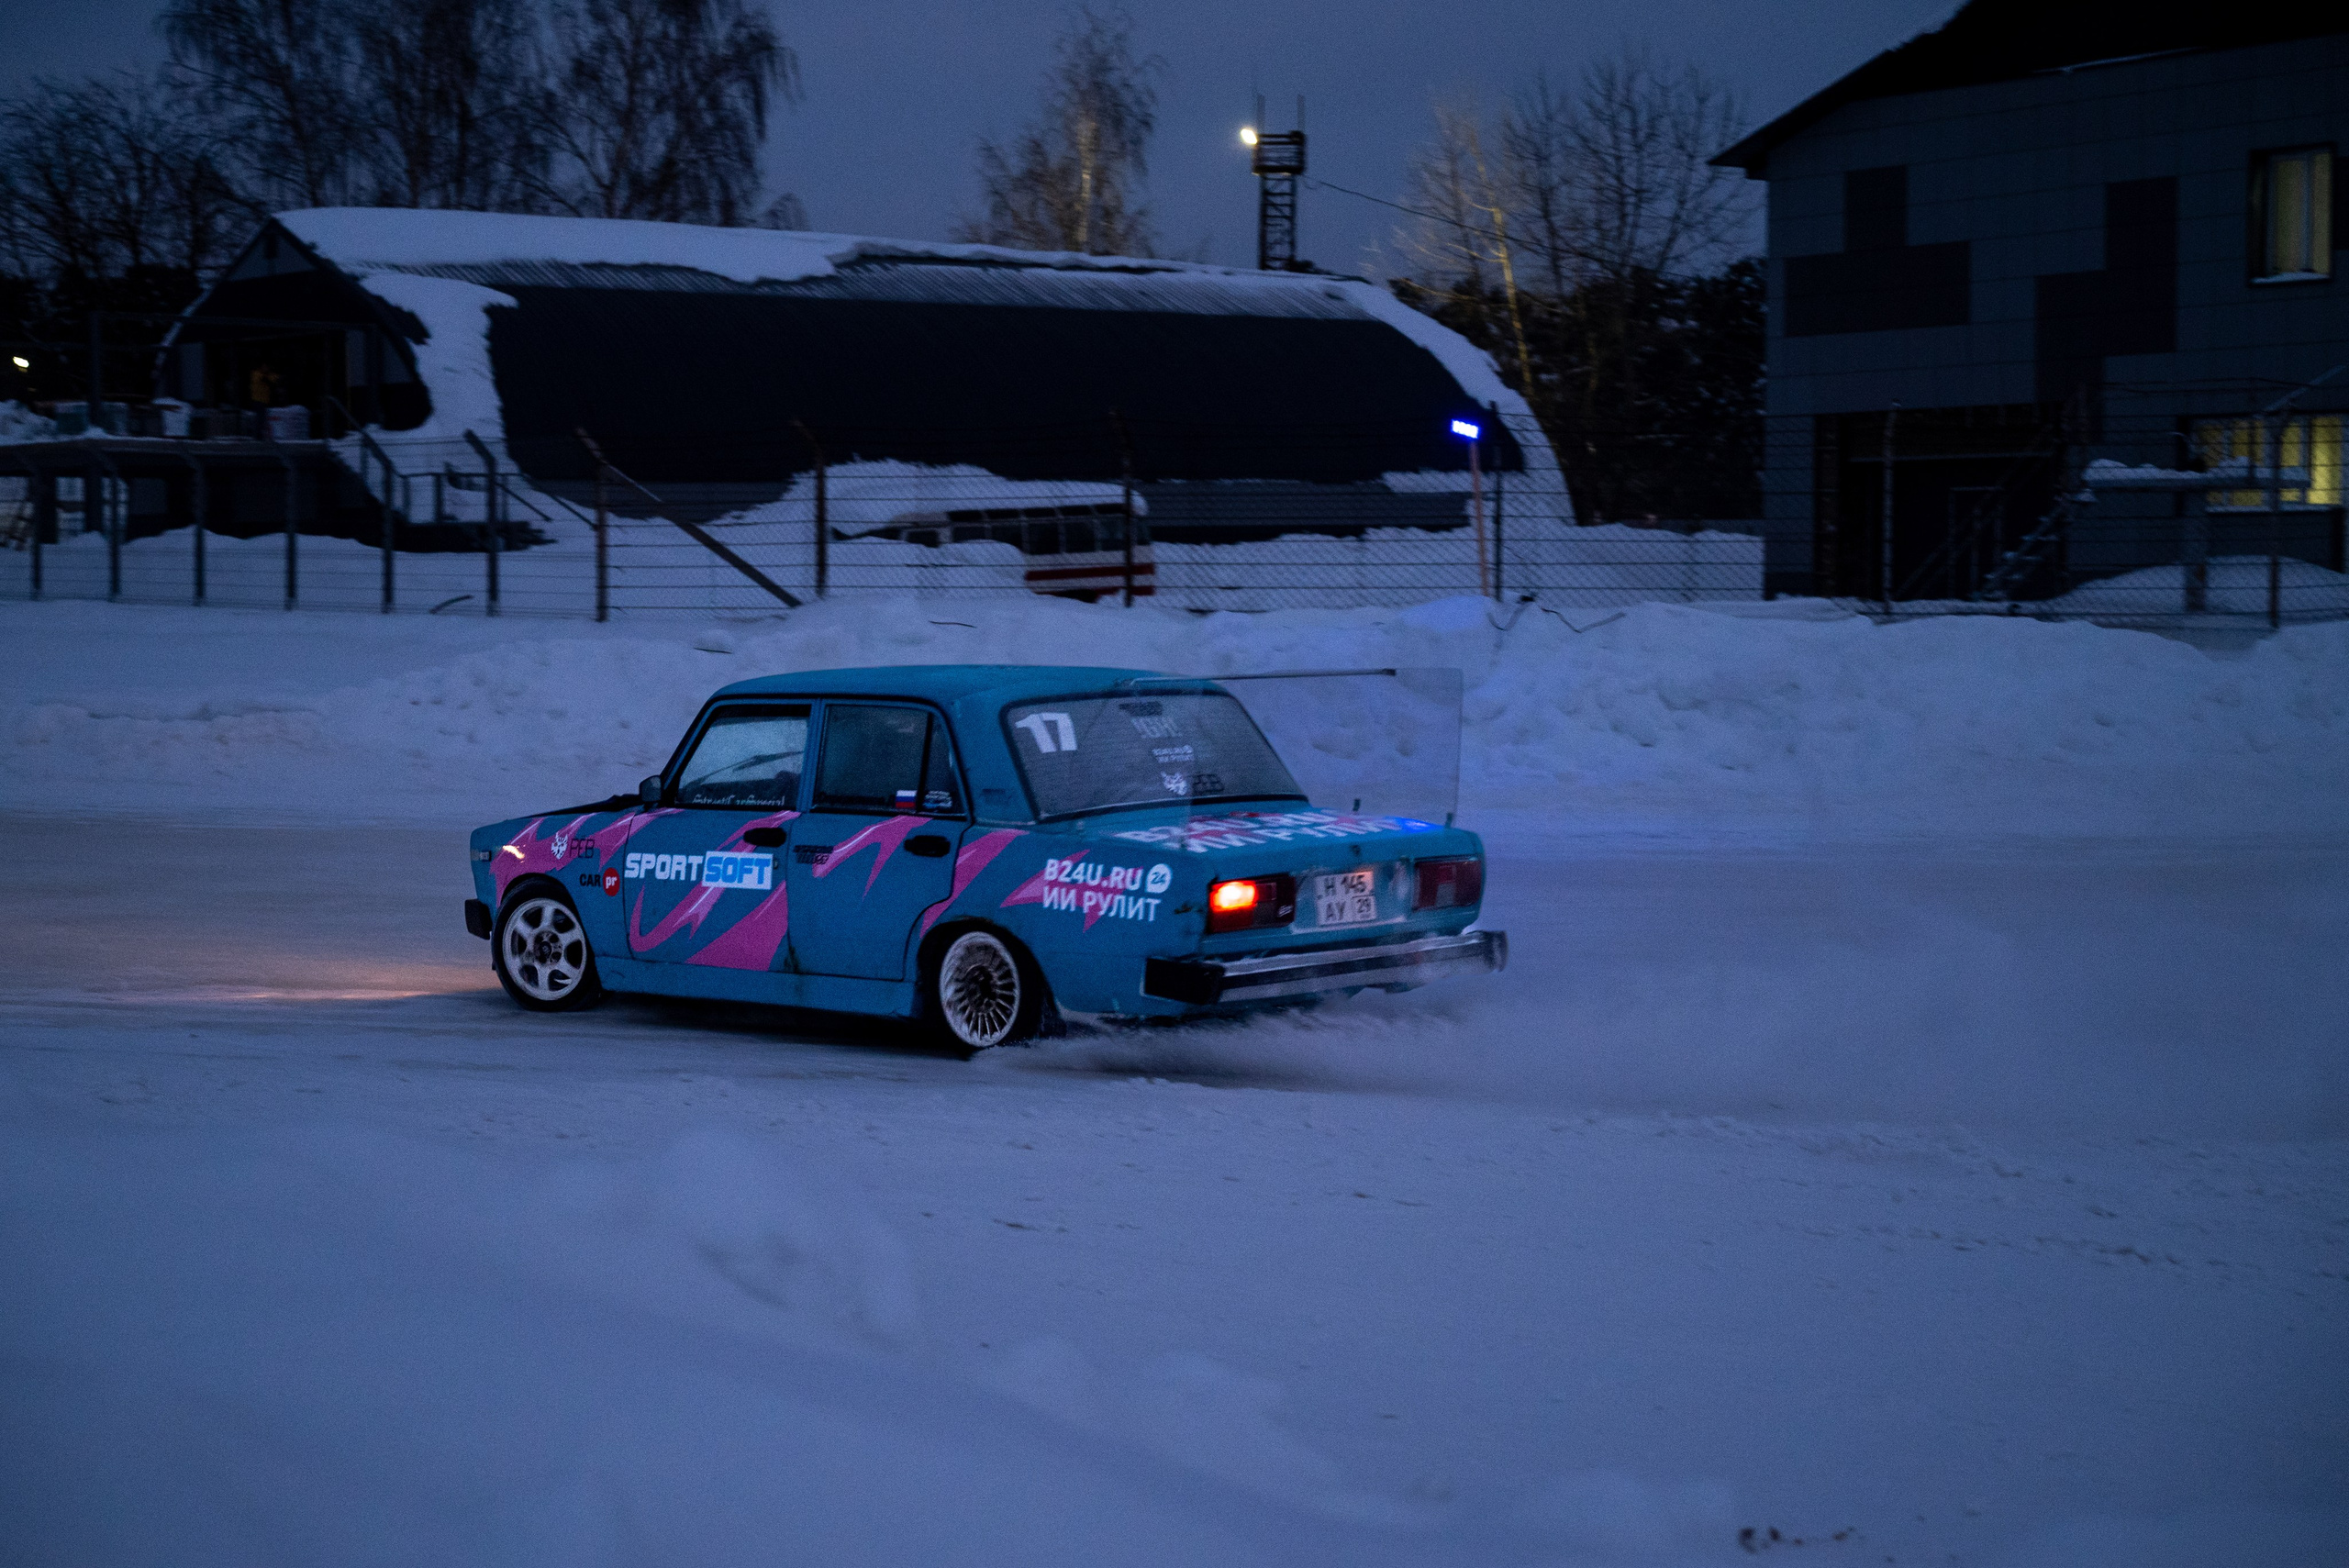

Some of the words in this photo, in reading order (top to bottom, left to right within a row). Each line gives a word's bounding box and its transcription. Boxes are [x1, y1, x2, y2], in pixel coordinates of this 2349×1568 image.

[1015, 712, 1077, 753] 17
[579, 874, 601, 887] CAR
[605, 876, 618, 889] pr
[624, 852, 704, 881] SPORT
[705, 857, 772, 884] SOFT
[1043, 859, 1144, 890] B24U.RU
[1042, 885, 1077, 912] ИИ
[1082, 890, 1162, 922] РУЛИТ
